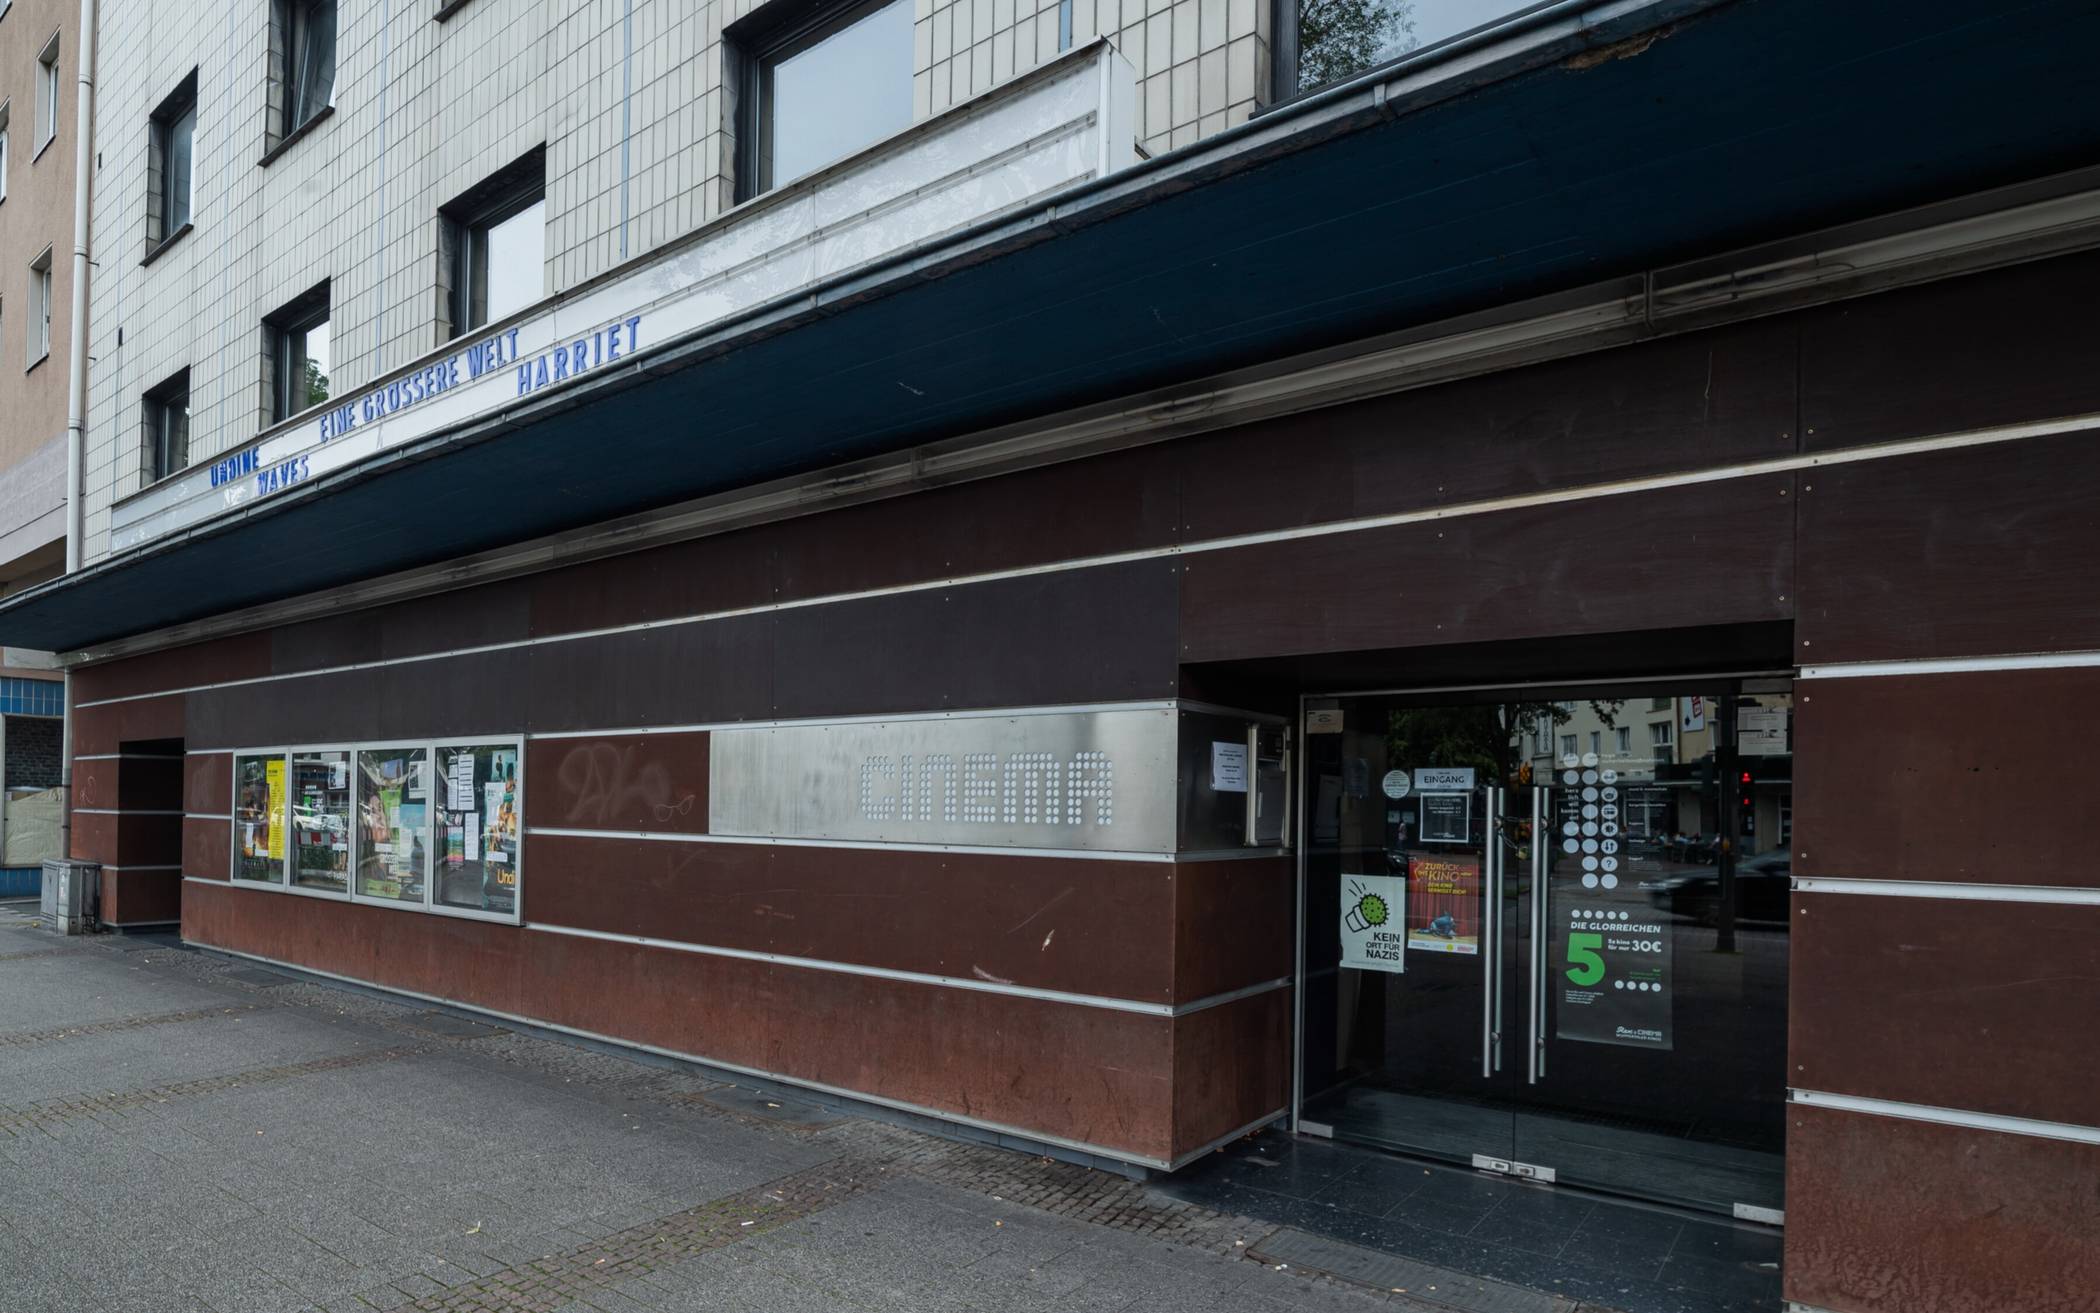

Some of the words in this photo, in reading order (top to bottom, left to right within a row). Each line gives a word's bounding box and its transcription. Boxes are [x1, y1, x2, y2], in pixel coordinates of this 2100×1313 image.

[518, 315, 640, 398] HARRIET
[319, 401, 356, 443] EINE
[466, 327, 519, 380] WELT
[211, 446, 259, 489] UNDINE
[257, 455, 309, 497] WAVES
[1423, 776, 1465, 784] EINGANG
[1424, 861, 1459, 870] ZURÜCK
[1428, 870, 1460, 881] KINO
[1570, 922, 1586, 930] DIE
[1590, 922, 1661, 933] GLORREICHEN
[1373, 932, 1400, 943] KEIN
[1366, 941, 1382, 949] ORT
[1384, 942, 1400, 951] FÜR
[1632, 940, 1661, 952] 30€
[1366, 950, 1400, 960] NAZIS
[1566, 932, 1605, 986] 5
